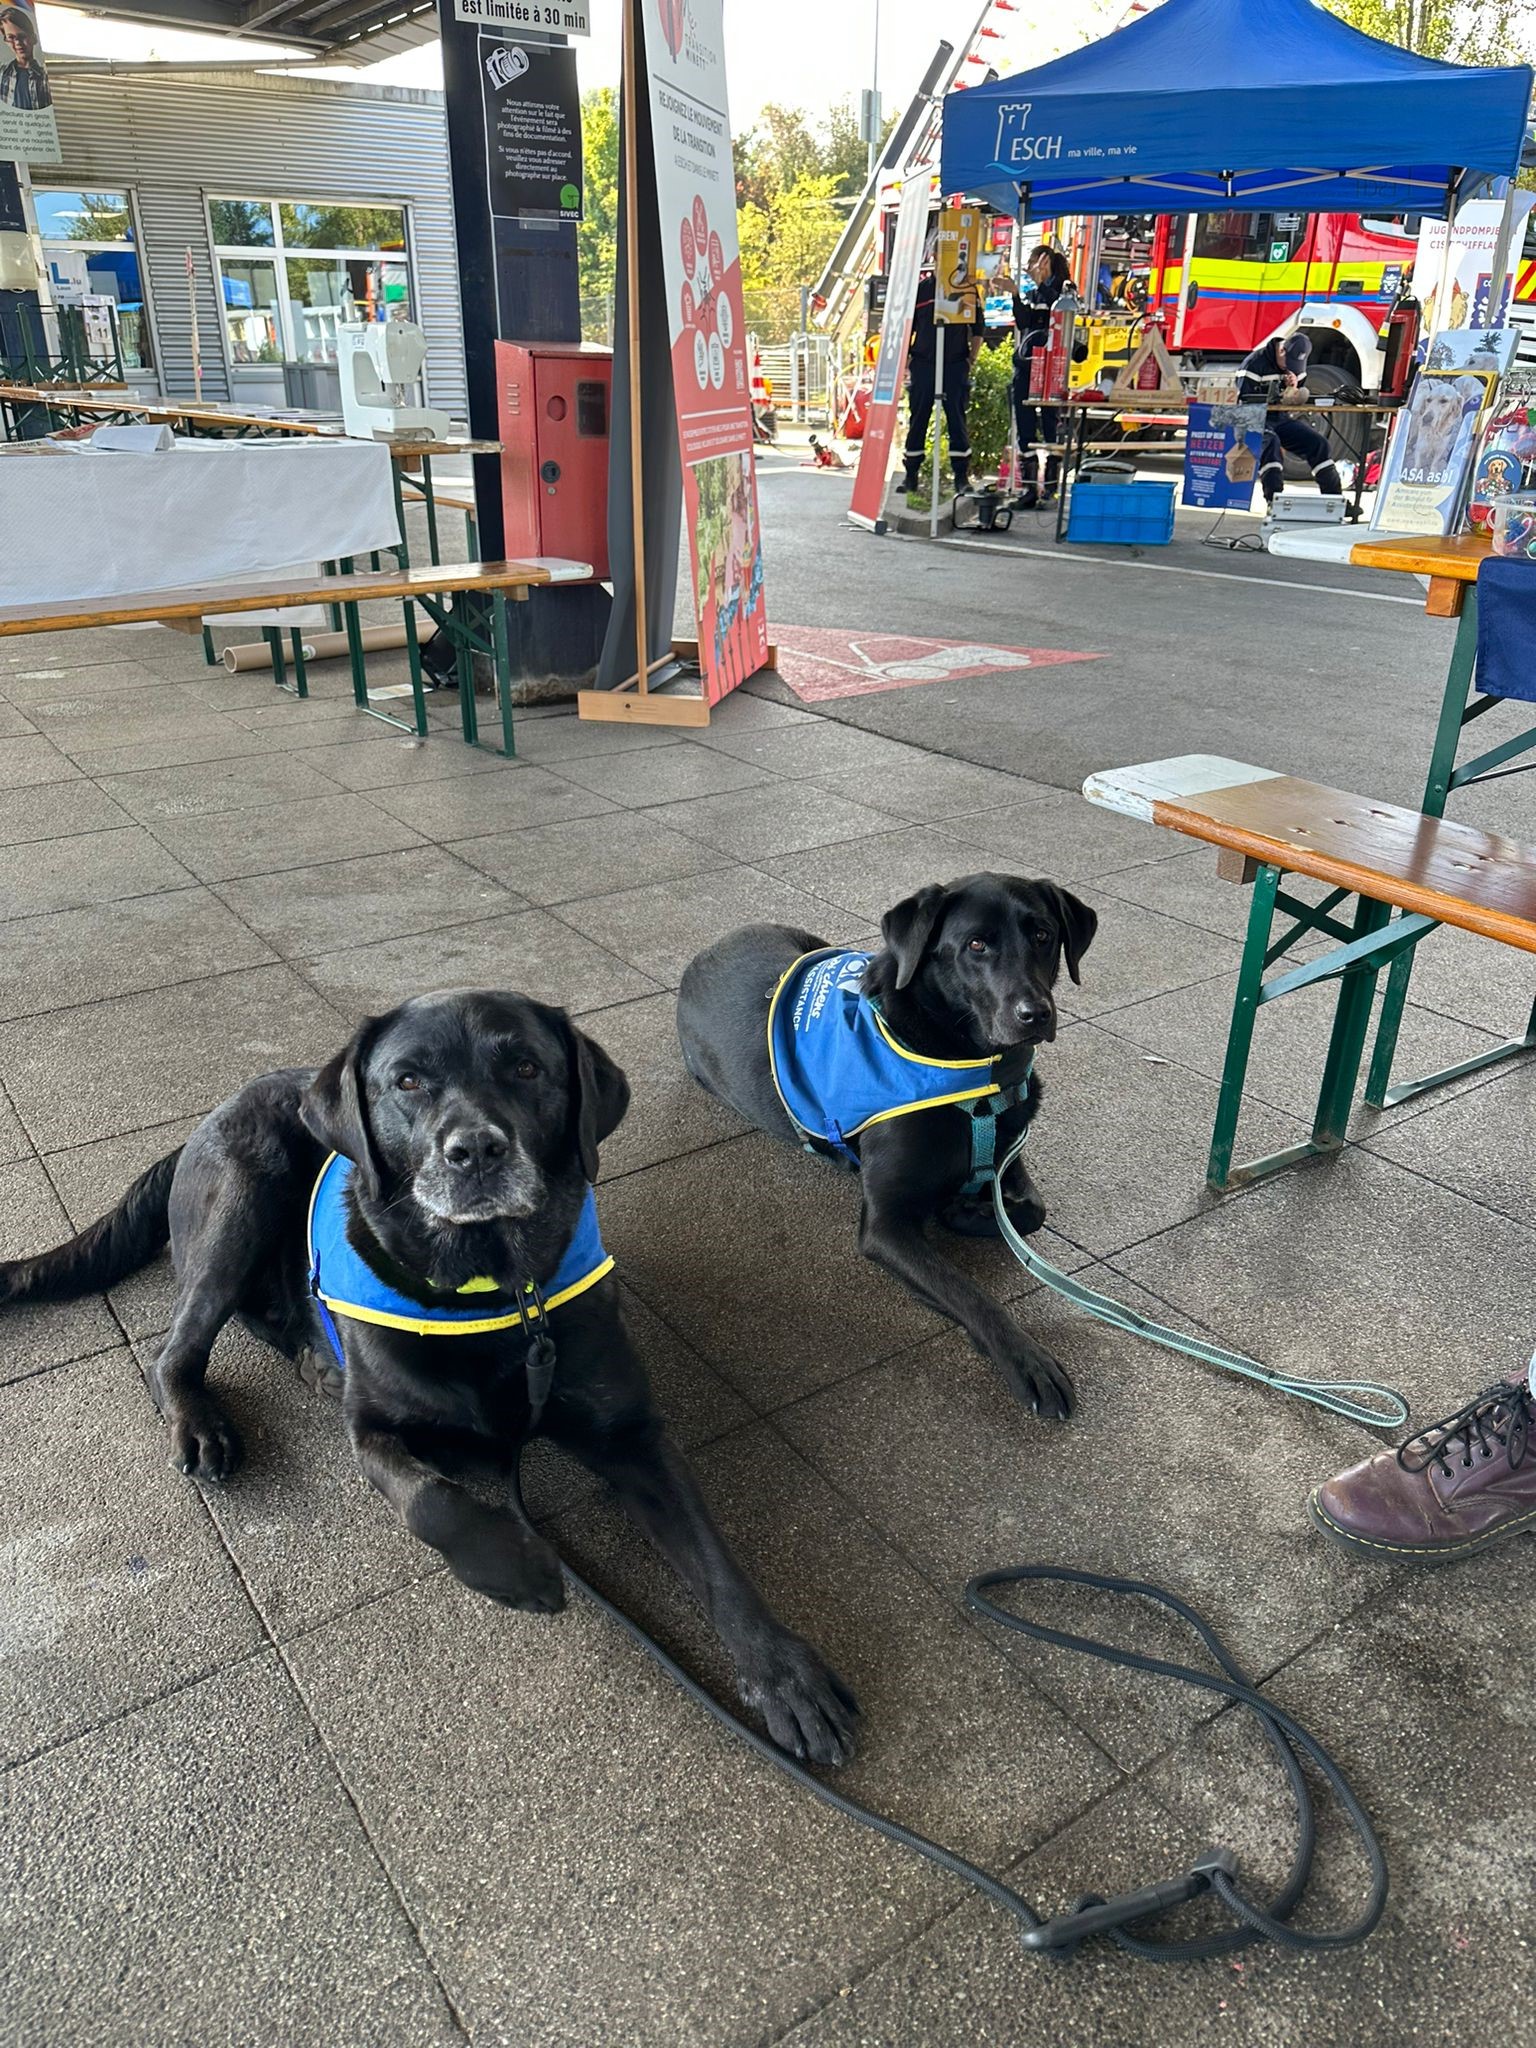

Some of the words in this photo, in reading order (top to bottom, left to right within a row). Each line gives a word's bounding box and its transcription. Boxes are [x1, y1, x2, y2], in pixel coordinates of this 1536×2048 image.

[462, 0, 482, 14] est
[486, 0, 529, 21] limitée
[534, 5, 541, 23] à
[544, 8, 560, 25] 30
[564, 11, 586, 29] min
[506, 98, 522, 107] Nous
[502, 106, 527, 115] attention
[538, 109, 543, 117] le
[545, 110, 554, 118] fait
[555, 112, 566, 120] que
[503, 130, 514, 138] fins
[515, 131, 522, 139] de
[498, 145, 505, 153] Si
[1010, 135, 1063, 161] ESCH
[1067, 149, 1081, 158] ma
[1083, 146, 1105, 158] ville,
[1107, 147, 1121, 156] ma
[1123, 144, 1138, 155] vie
[505, 154, 528, 162] veuillez
[543, 157, 567, 166] adresser
[515, 163, 550, 172] directement
[505, 169, 541, 180] photographe
[560, 210, 579, 218] SIVEC
[1429, 225, 1517, 236] JUGNDPOMPJE
[1201, 390, 1236, 403] 112
[1400, 467, 1424, 482] ASA
[1427, 468, 1454, 483] asbl
